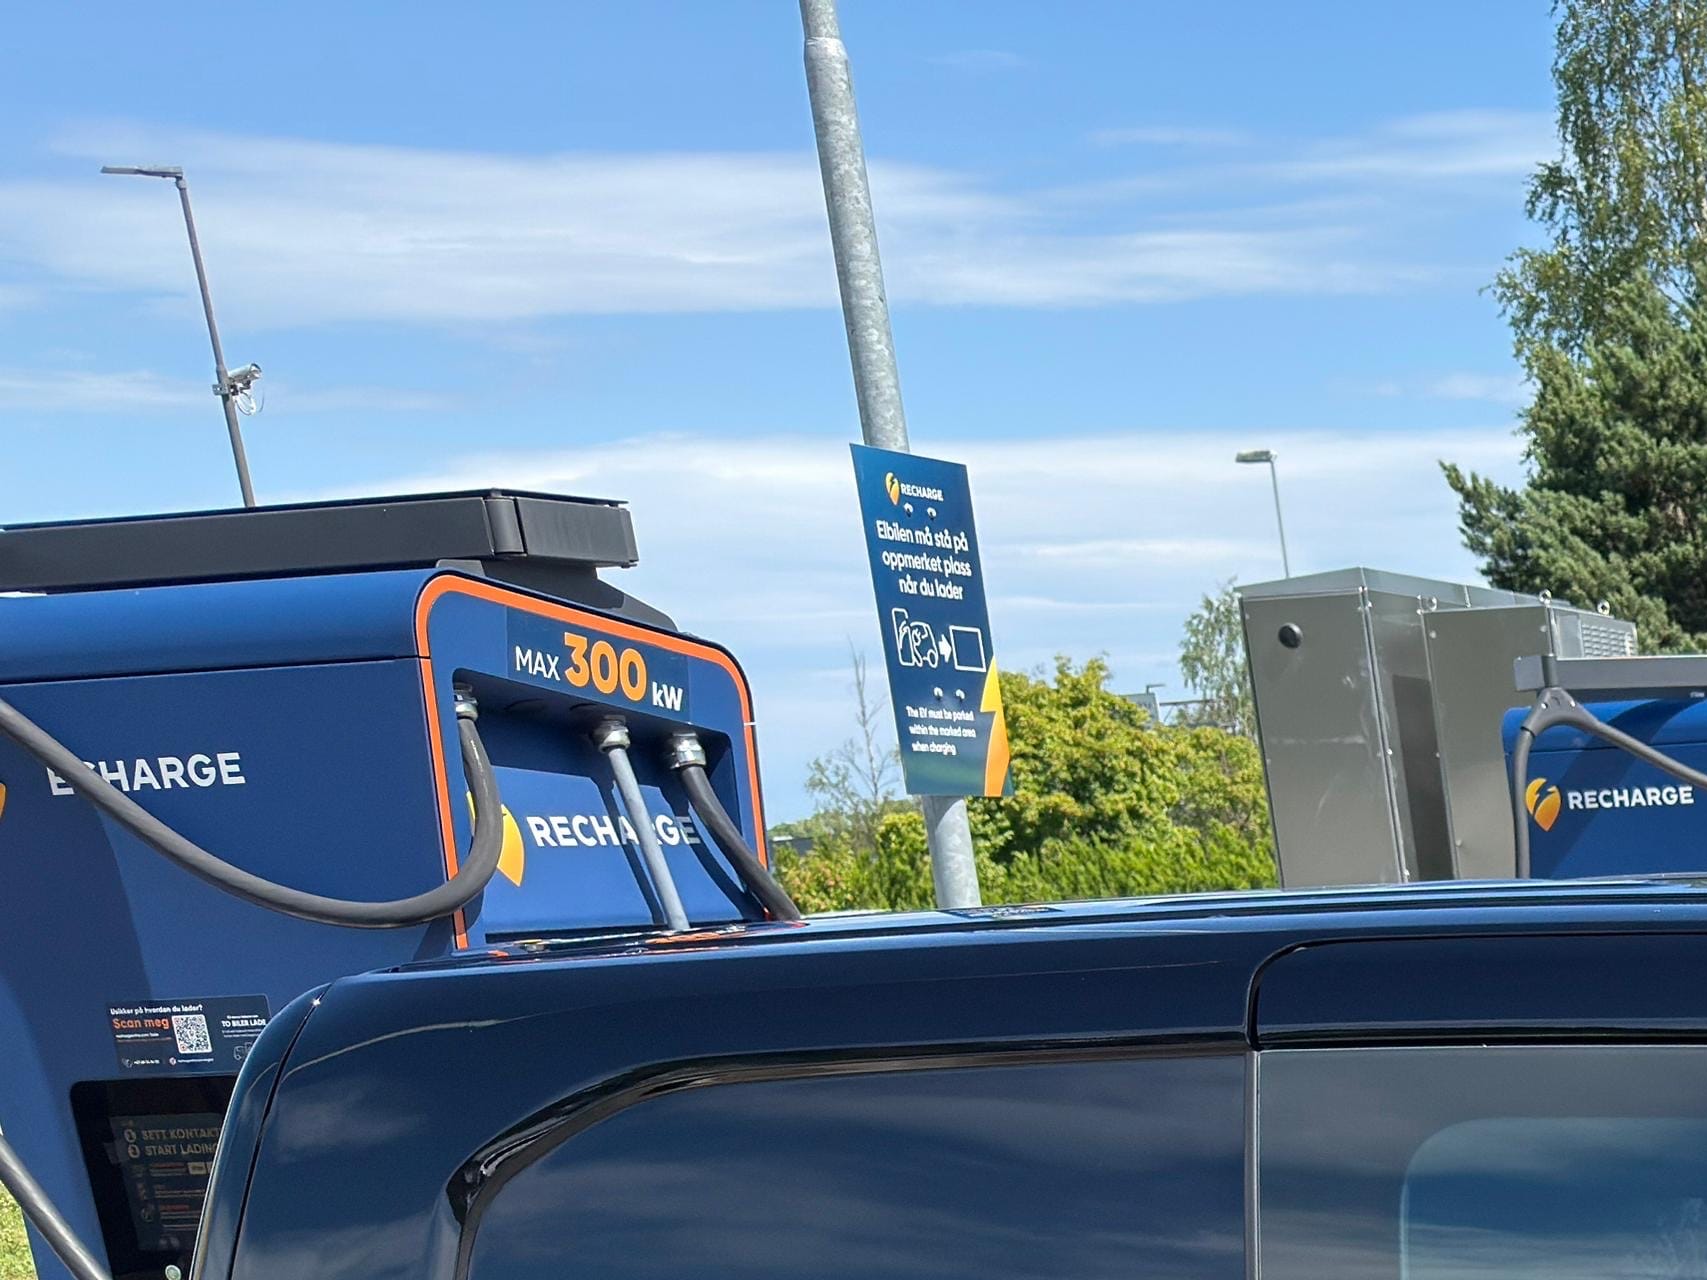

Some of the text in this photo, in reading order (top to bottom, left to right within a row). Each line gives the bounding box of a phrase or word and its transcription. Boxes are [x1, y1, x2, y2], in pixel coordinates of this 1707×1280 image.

[901, 483, 944, 501] RECHARGE
[876, 520, 969, 554] Elbilen må stå på
[882, 551, 972, 578] oppmerket plass
[899, 574, 963, 600] når du lader
[515, 632, 683, 711] MAX 300 kW
[47, 752, 246, 796] EHARGE
[1567, 786, 1695, 810] RECHARGE
[526, 815, 701, 847] RECHAGE
[112, 1018, 169, 1029] Scan meg
[145, 1145, 176, 1156] START
